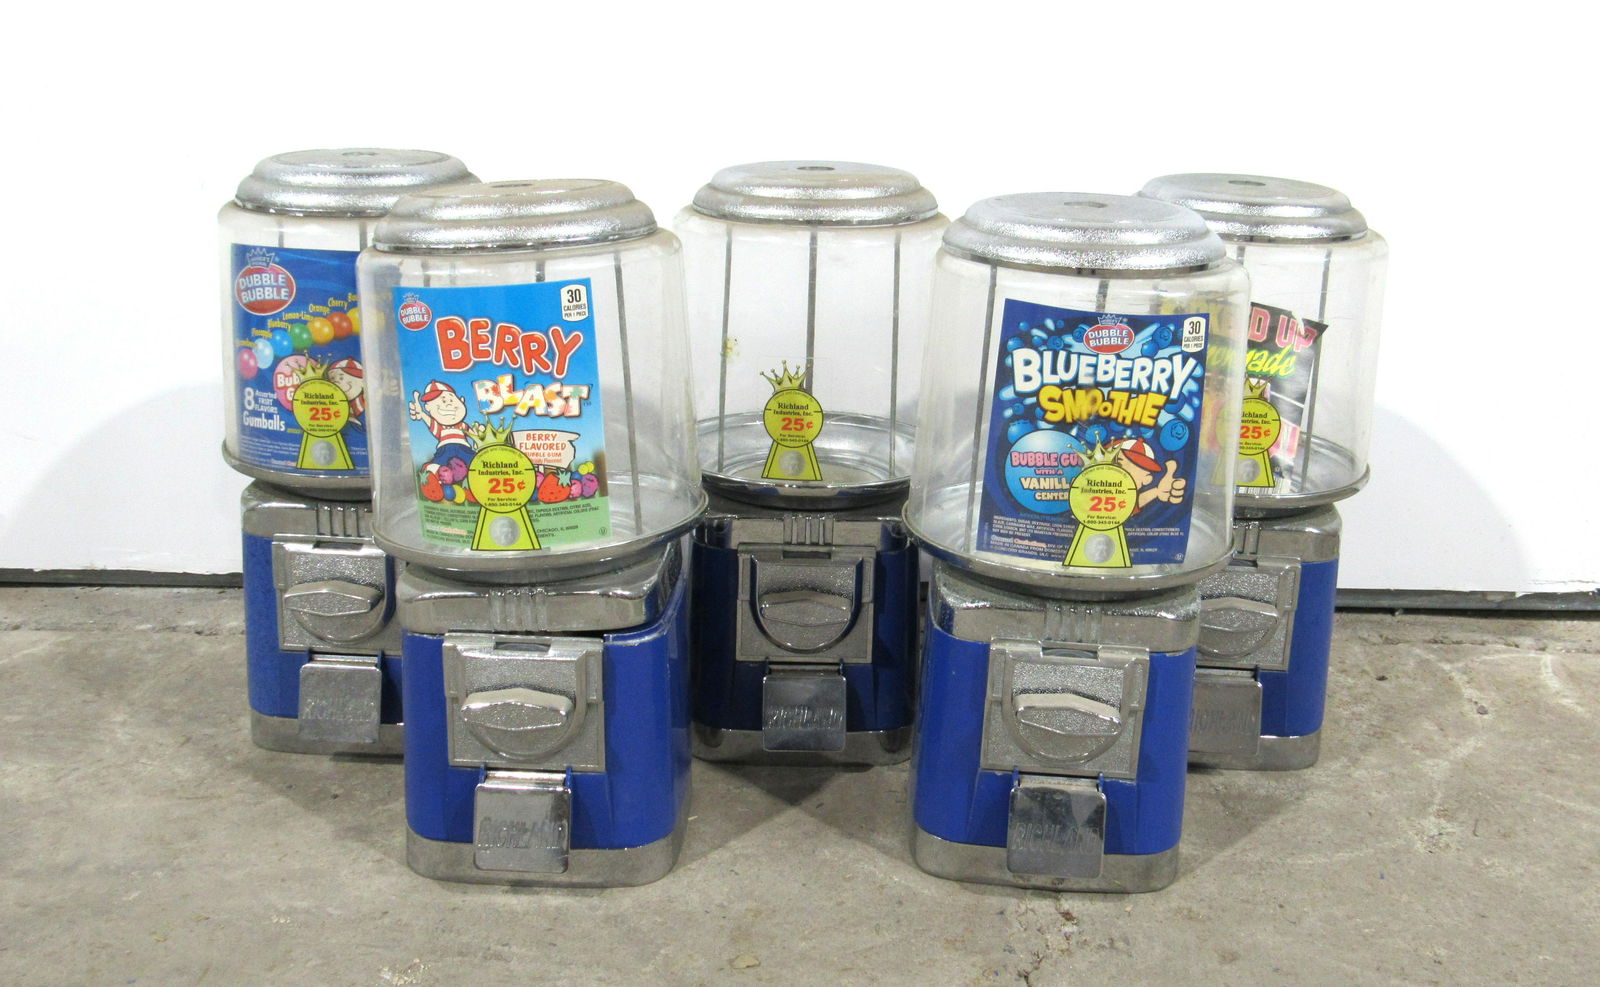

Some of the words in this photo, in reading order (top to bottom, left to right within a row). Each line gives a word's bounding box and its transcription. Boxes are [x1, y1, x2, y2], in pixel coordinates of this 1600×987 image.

[239, 273, 287, 289] DUBBLE
[241, 286, 290, 304] BUBBLE
[567, 288, 582, 303] 30
[400, 306, 427, 317] DUBBLE
[563, 303, 587, 312] CALORIES
[402, 314, 429, 325] BUBBLE
[1188, 320, 1201, 335] 30
[1088, 329, 1129, 339] DUBBLE
[1184, 335, 1204, 343] CALORIES
[435, 316, 583, 379] BERRY
[1089, 337, 1130, 347] BUBBLE
[1012, 348, 1197, 400] BLUEBERRY
[244, 387, 255, 410] 8
[304, 392, 334, 400] Richland
[473, 374, 590, 418] BLAST
[1039, 385, 1168, 427] SMOOTHIE
[243, 411, 286, 431] Gumballs
[526, 432, 557, 441] BERRY
[519, 441, 567, 451] FLAVORED
[1010, 451, 1059, 467] BUBBLE
[482, 461, 519, 469] Richland
[478, 469, 511, 477] Industries,
[1020, 477, 1072, 490] VANILL
[1087, 480, 1123, 488] Richland
[1081, 487, 1114, 495] Industries,
